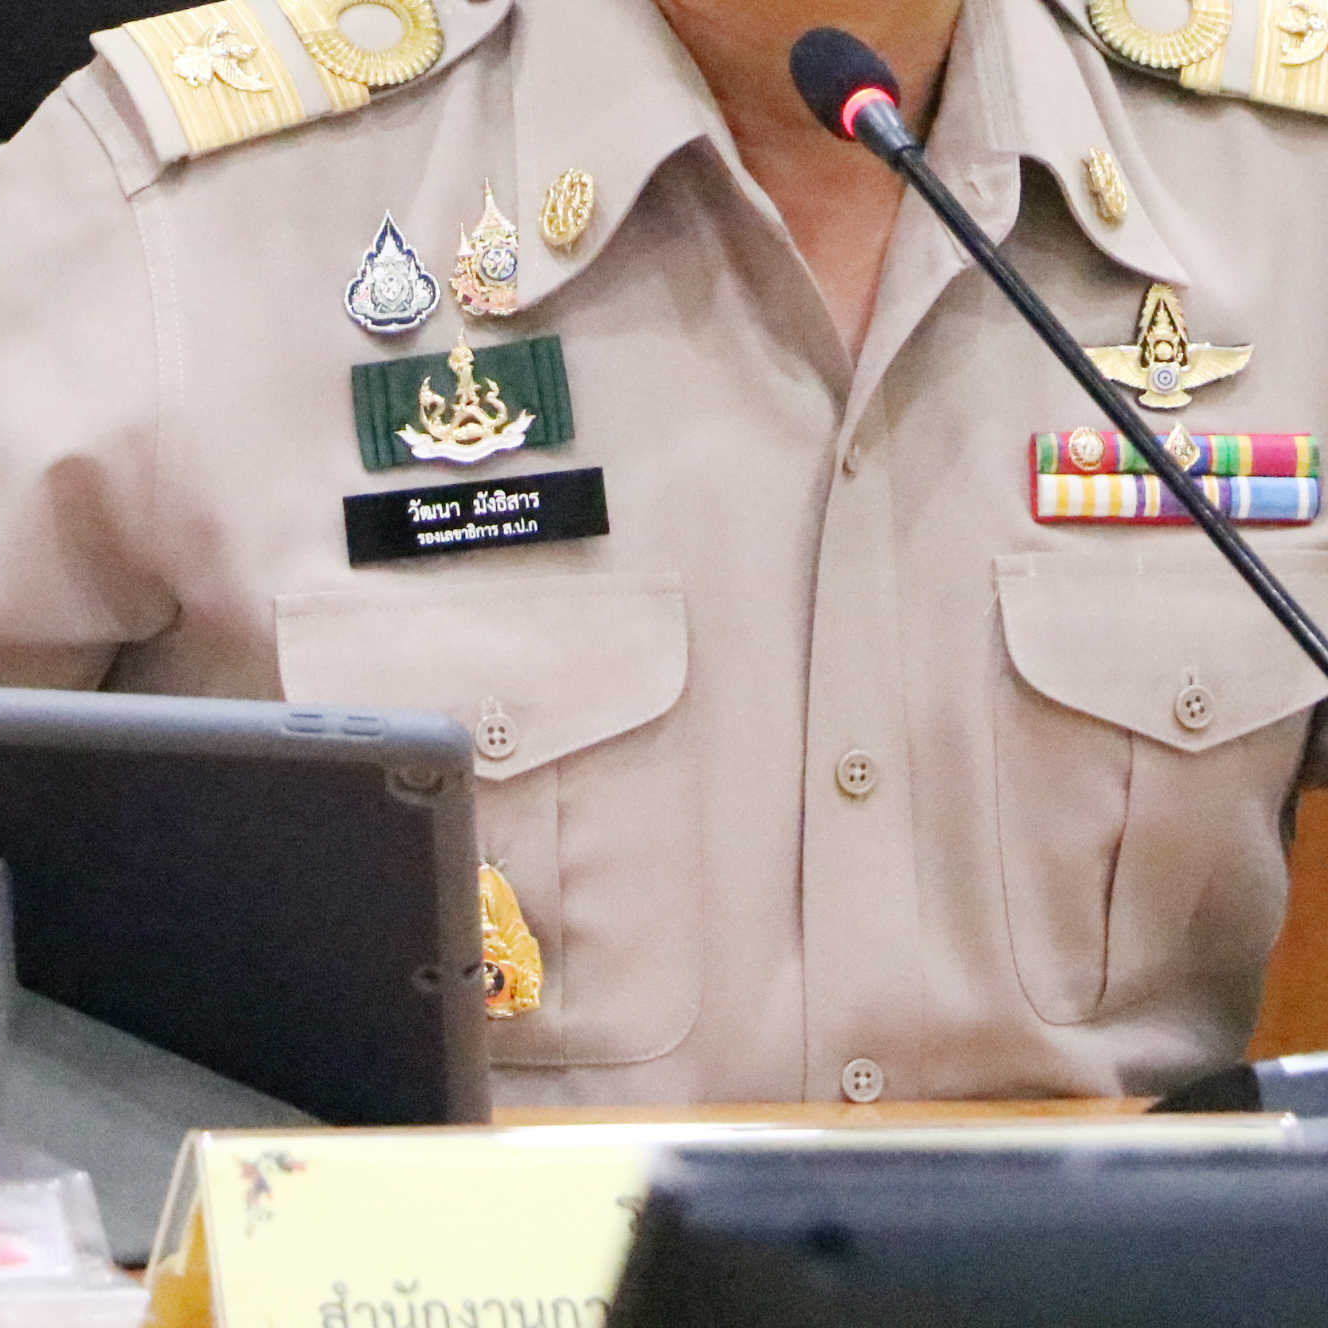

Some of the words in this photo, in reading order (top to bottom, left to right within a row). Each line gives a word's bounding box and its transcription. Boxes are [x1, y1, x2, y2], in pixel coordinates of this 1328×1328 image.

[407, 498, 461, 522] วัฒนา
[473, 489, 540, 515] มังธิสาร
[417, 522, 499, 545] รองเลขาธิการ
[502, 517, 539, 535] ส.ป.ก
